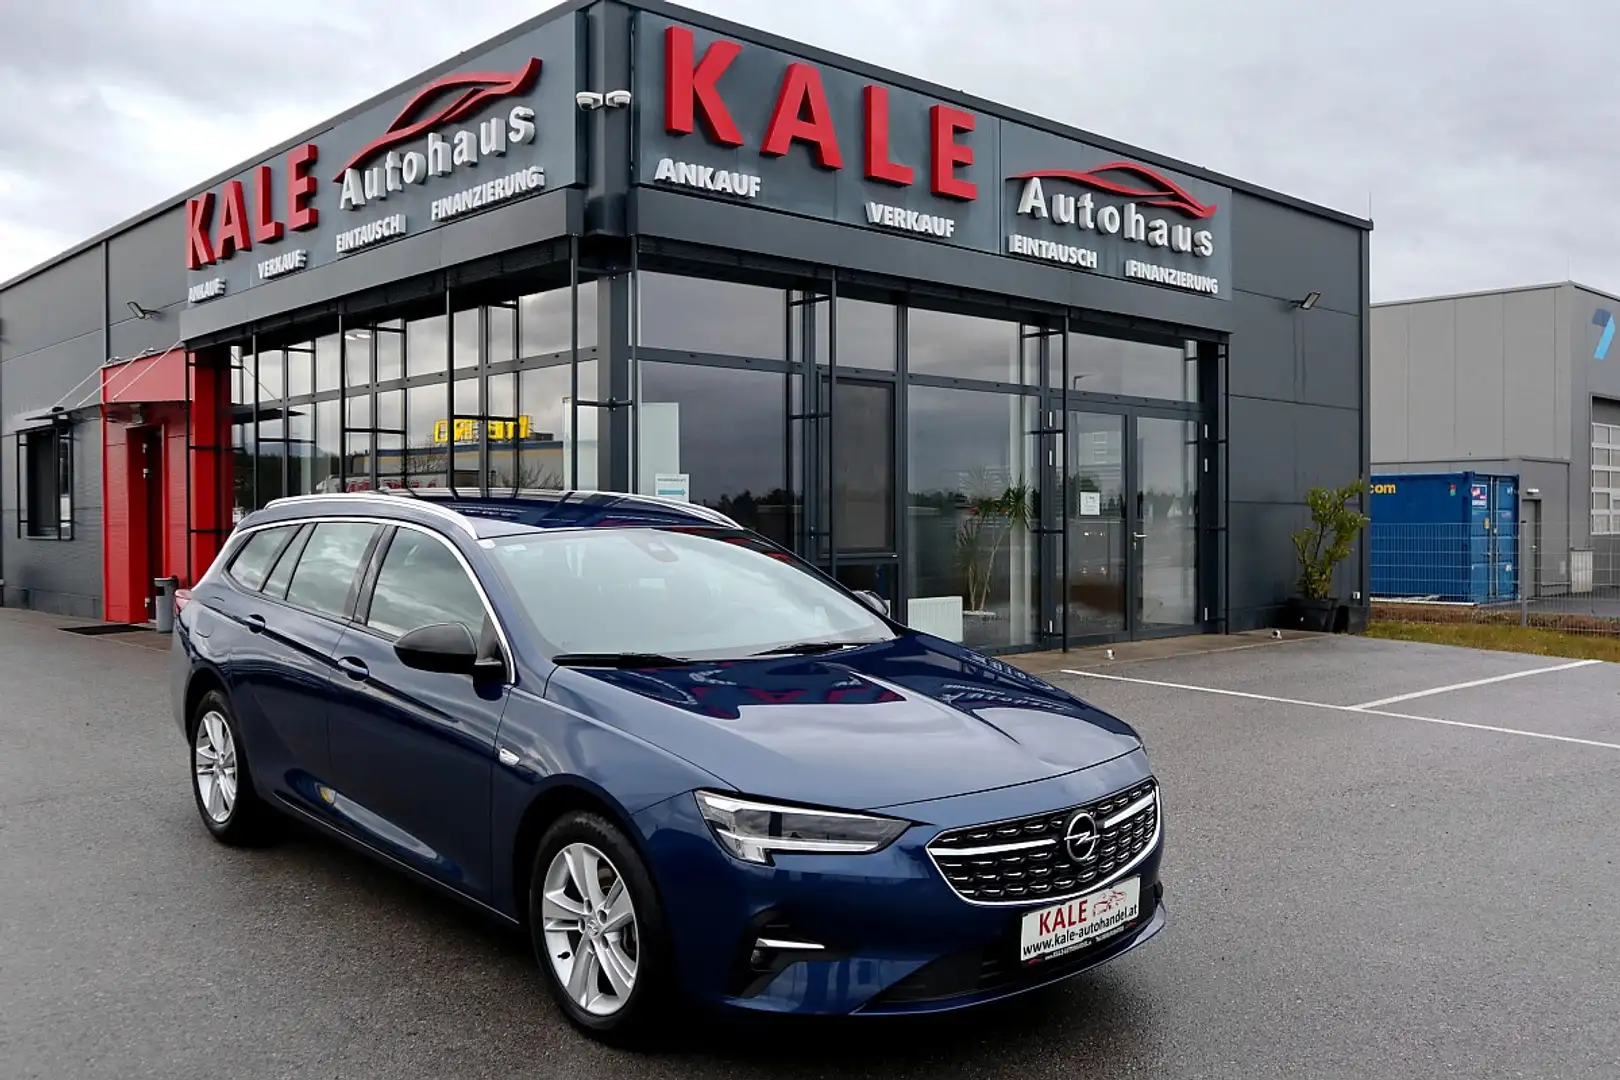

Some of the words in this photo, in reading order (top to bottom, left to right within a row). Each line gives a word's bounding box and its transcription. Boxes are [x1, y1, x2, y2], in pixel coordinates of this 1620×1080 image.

[340, 105, 536, 210] Autohaus
[665, 25, 977, 201] KALE
[186, 144, 319, 270] KALE
[257, 249, 307, 280] VERKAUF
[336, 213, 406, 254] EINTAUSCH
[431, 166, 545, 222] FINANZIERUNG
[654, 157, 762, 198] ANKAUF
[865, 201, 955, 239] VERKAUF
[1008, 234, 1098, 269] EINTAUSCH
[1125, 260, 1219, 294] FINANZIERUNG
[1016, 176, 1214, 258] Autohaus
[1023, 904, 1137, 956] www.kale-autohandel.at
[1039, 899, 1089, 937] KALE
